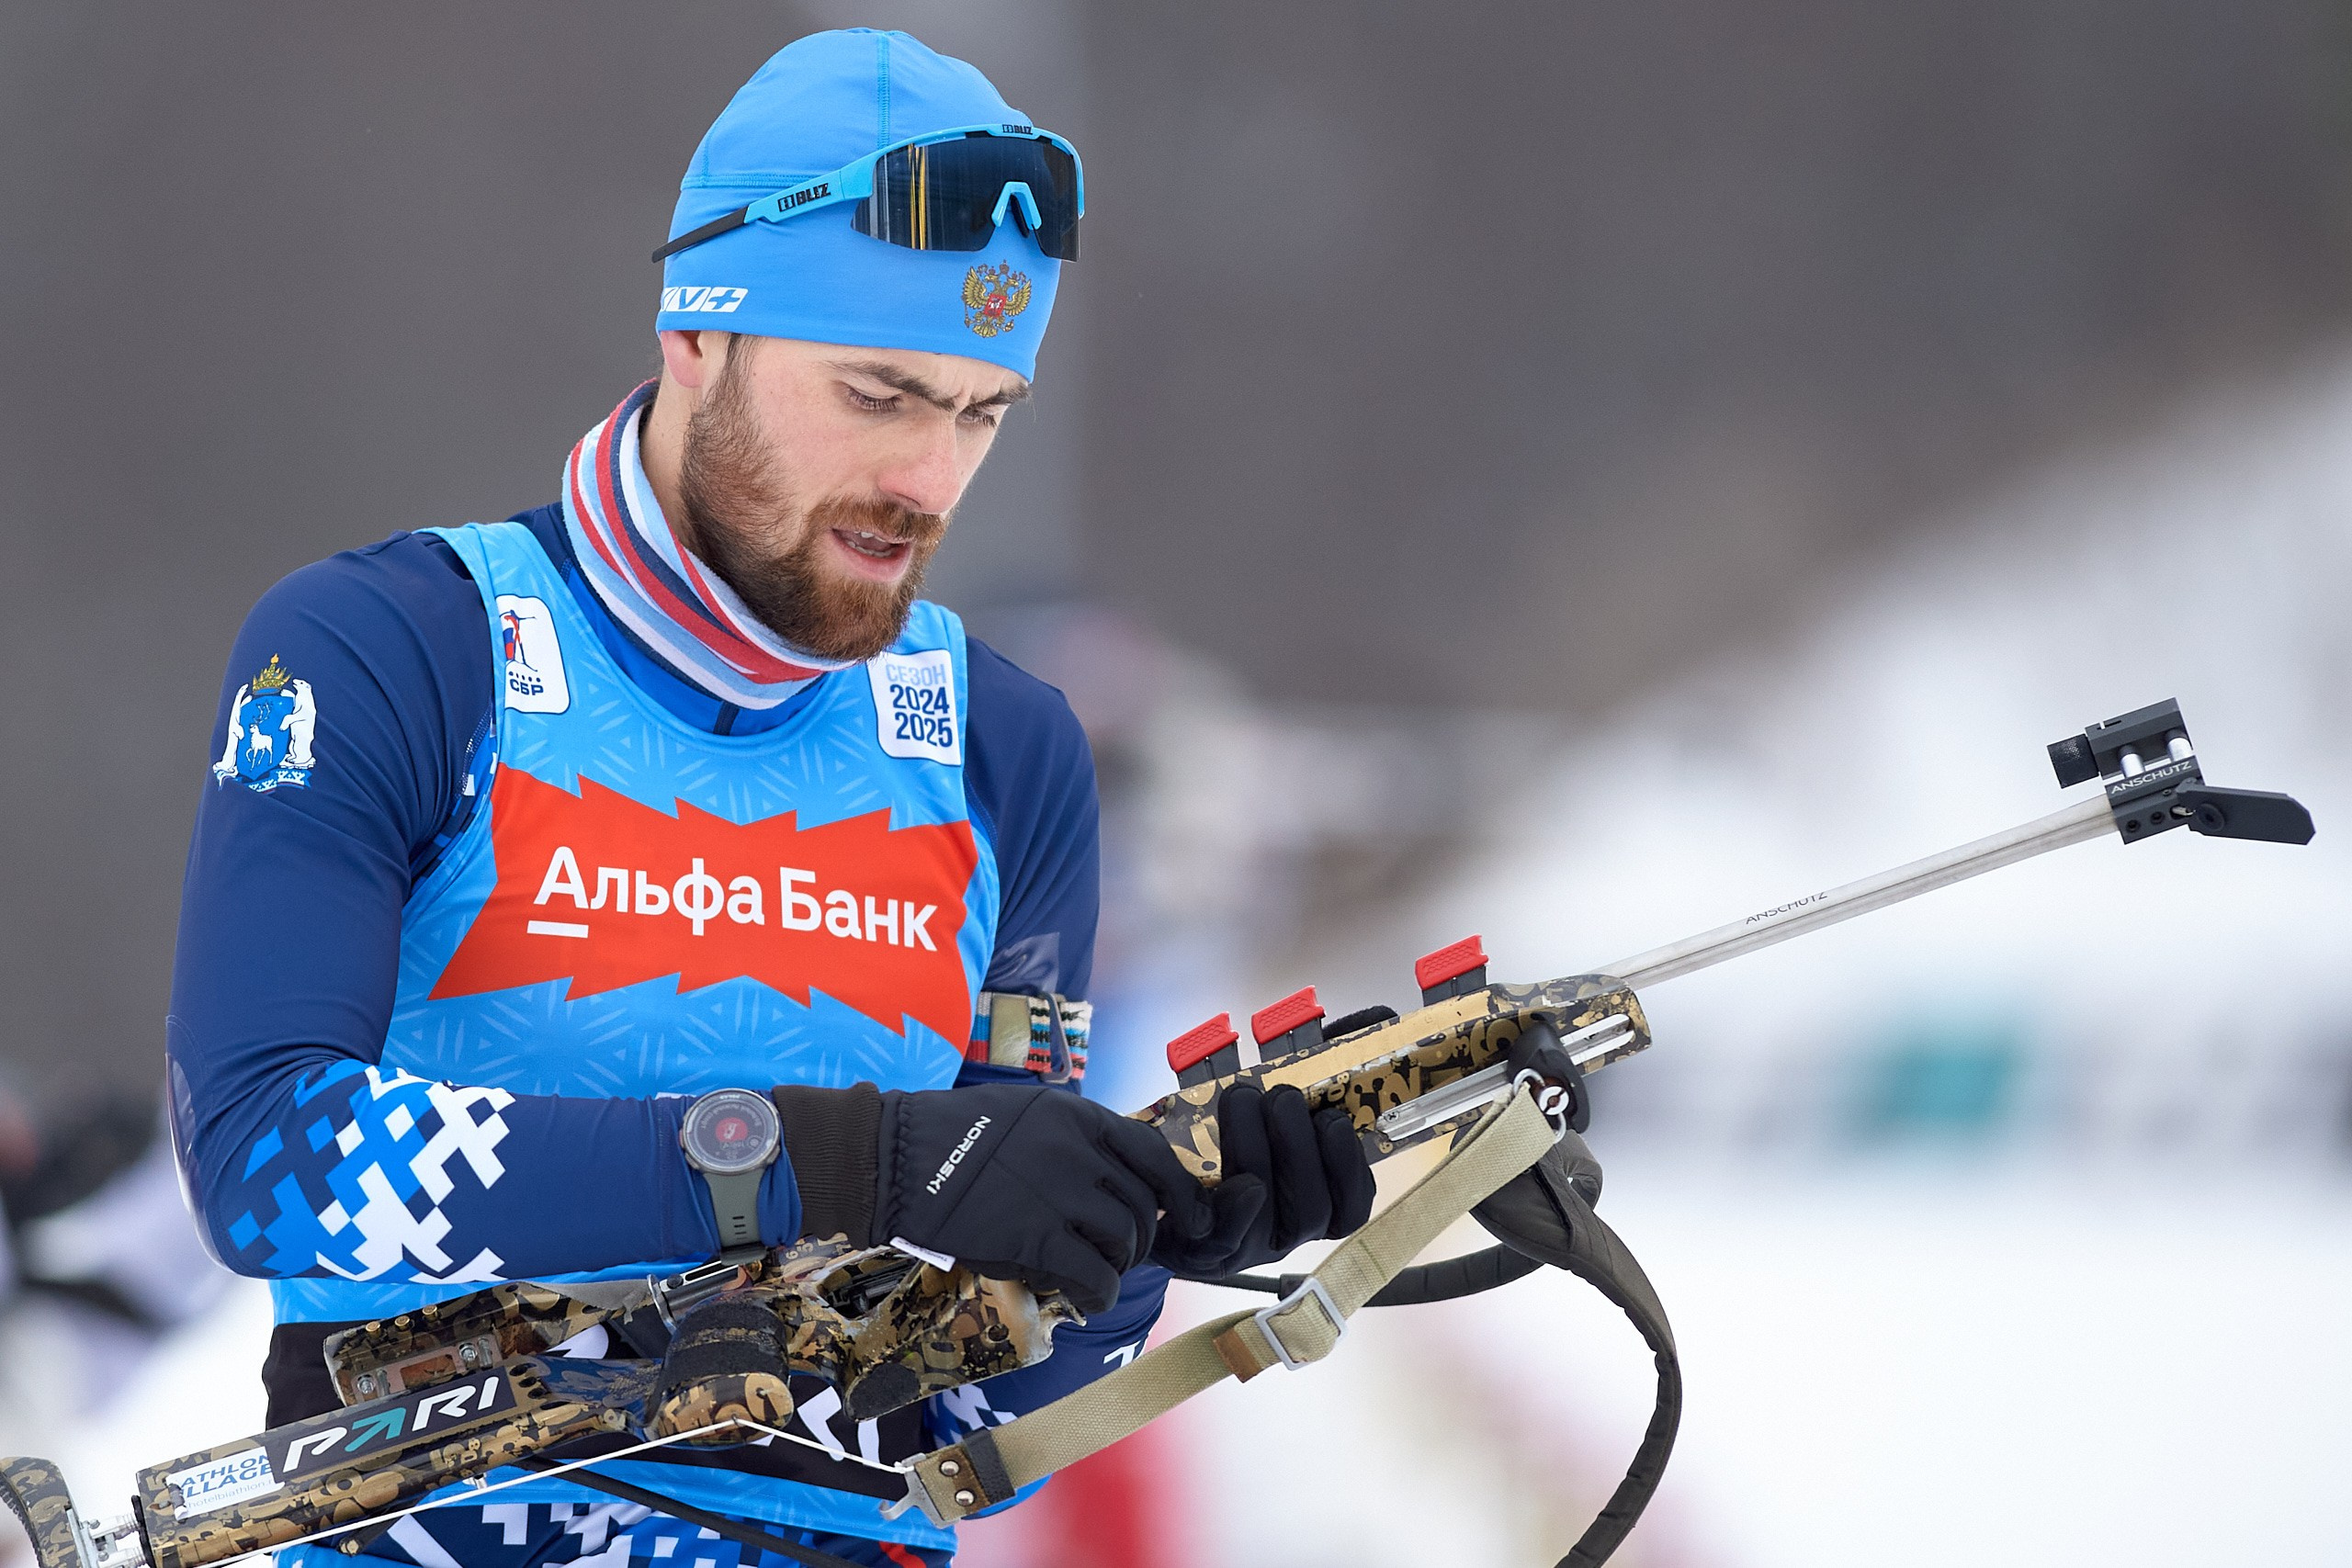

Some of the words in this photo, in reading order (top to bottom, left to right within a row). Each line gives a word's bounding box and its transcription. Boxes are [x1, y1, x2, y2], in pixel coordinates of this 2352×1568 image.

[509, 678, 544, 695] СБР
[885, 663, 947, 686] СЕЗОН
[889, 683, 950, 716] 2024
[895, 712, 953, 748] 2025
[533, 845, 764, 937] Альфа
[779, 865, 938, 952] Банк
[926, 1115, 992, 1194] NORDSKI
[282, 1376, 500, 1473] PARI
